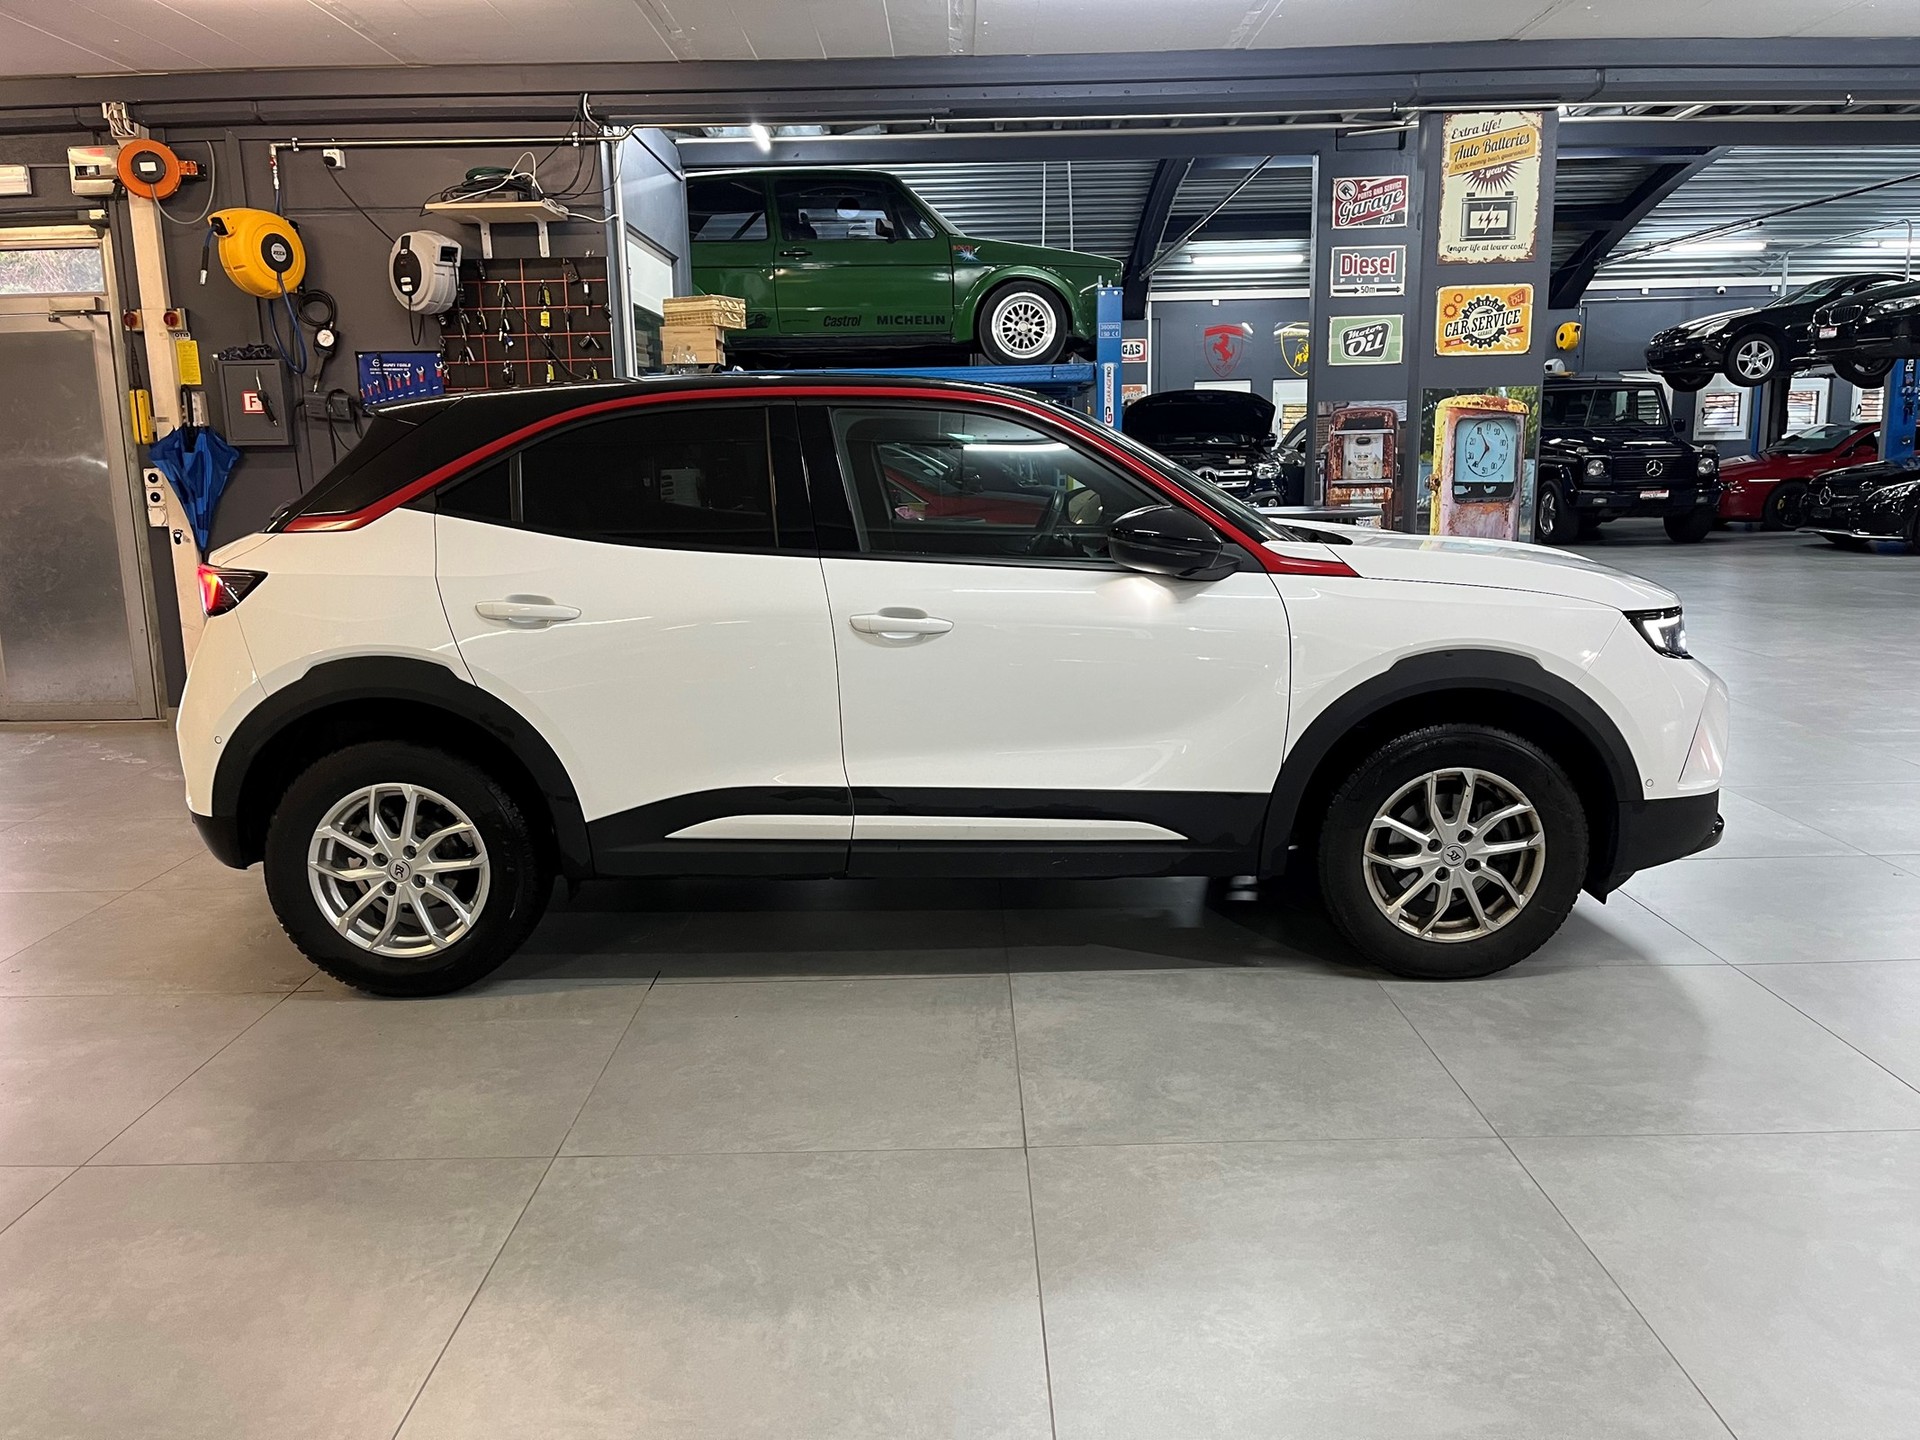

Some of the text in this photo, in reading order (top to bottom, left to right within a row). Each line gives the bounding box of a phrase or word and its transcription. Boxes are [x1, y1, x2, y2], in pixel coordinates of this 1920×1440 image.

[1451, 118, 1502, 140] Extra life!
[1454, 132, 1530, 163] Auto Batteries
[1479, 165, 1508, 179] 2 years
[1339, 189, 1404, 225] Garage
[1446, 244, 1468, 253] Longer
[1469, 243, 1481, 252] life
[1490, 243, 1508, 251] lower
[1341, 250, 1397, 277] Diesel
[1360, 286, 1376, 294] 50m
[823, 315, 862, 327] Castrol
[876, 315, 946, 326] MICHELIN
[1445, 309, 1521, 338] CAR SERVICE
[1347, 325, 1383, 340] Motor
[1122, 344, 1141, 355] GAS
[1346, 332, 1384, 356] Oil
